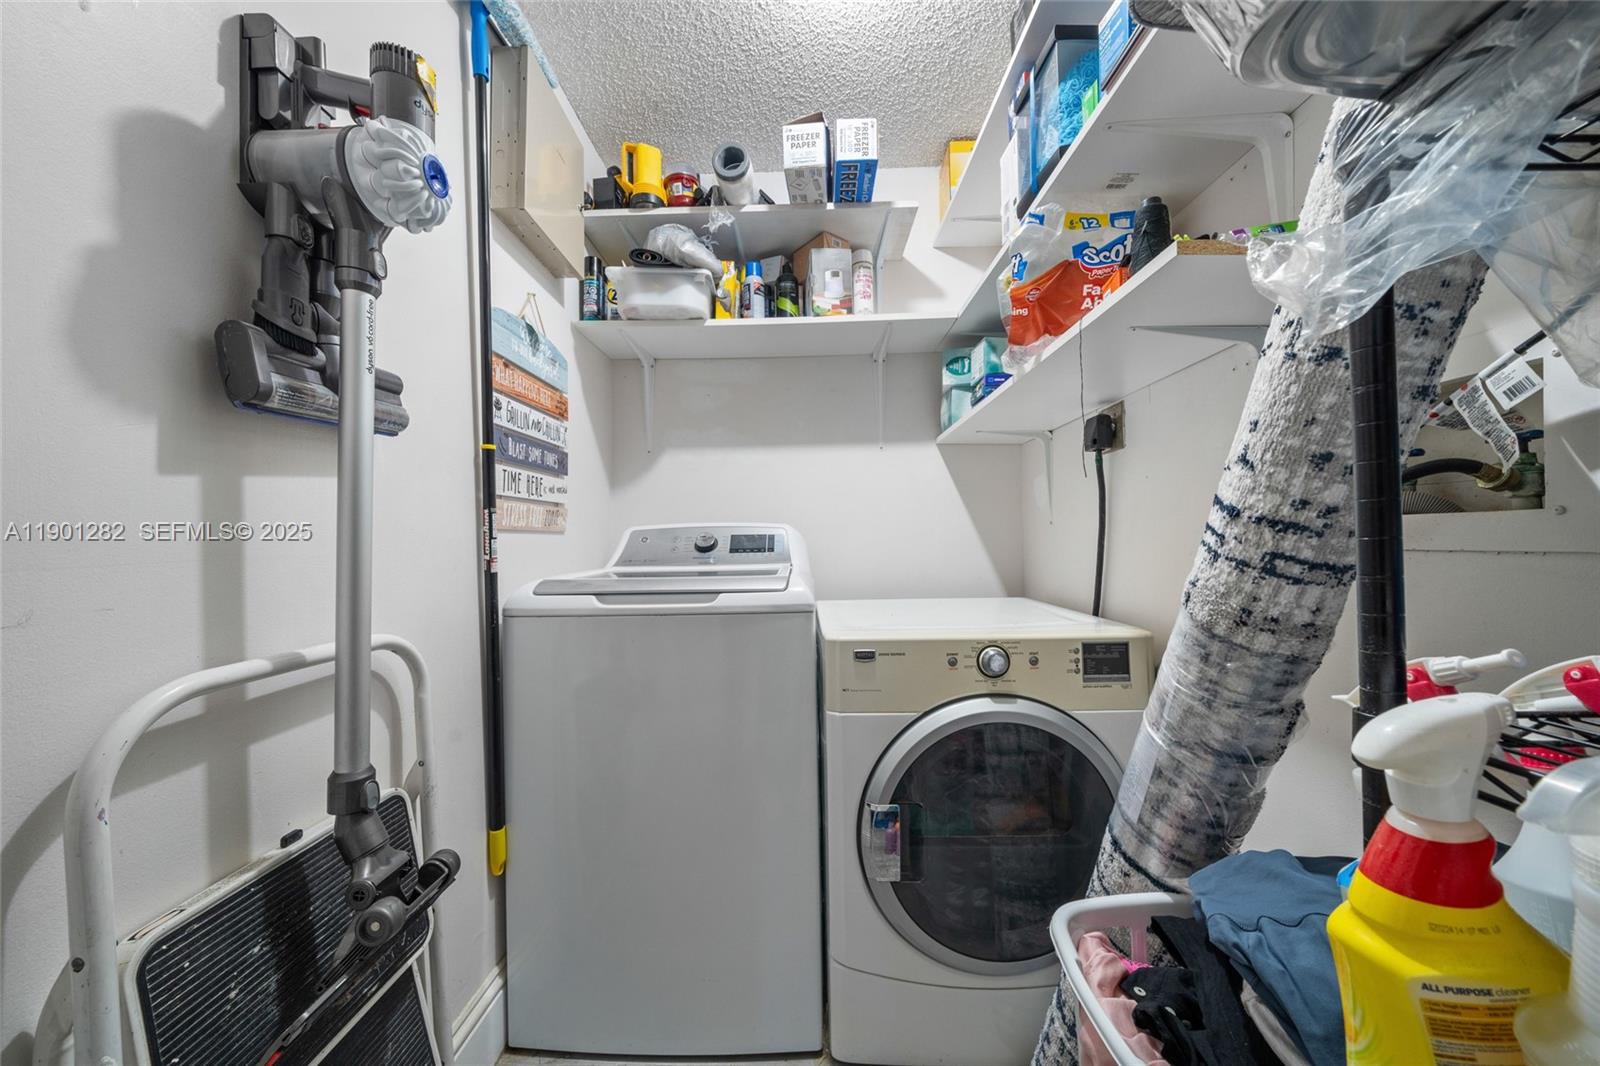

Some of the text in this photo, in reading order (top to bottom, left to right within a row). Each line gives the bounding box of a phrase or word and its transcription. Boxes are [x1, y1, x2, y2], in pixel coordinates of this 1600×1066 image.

[786, 132, 820, 142] FREEZER
[790, 141, 817, 150] PAPER
[861, 122, 869, 157] FREEZER
[1079, 217, 1100, 229] 12
[1082, 233, 1133, 264] Scot
[1083, 283, 1103, 297] Fa
[366, 298, 374, 336] cord-free
[365, 348, 374, 375] dyson
[502, 468, 521, 495] TIME
[527, 474, 543, 498] HERE
[1421, 982, 1531, 997] ALL PURPOSE cleaner
